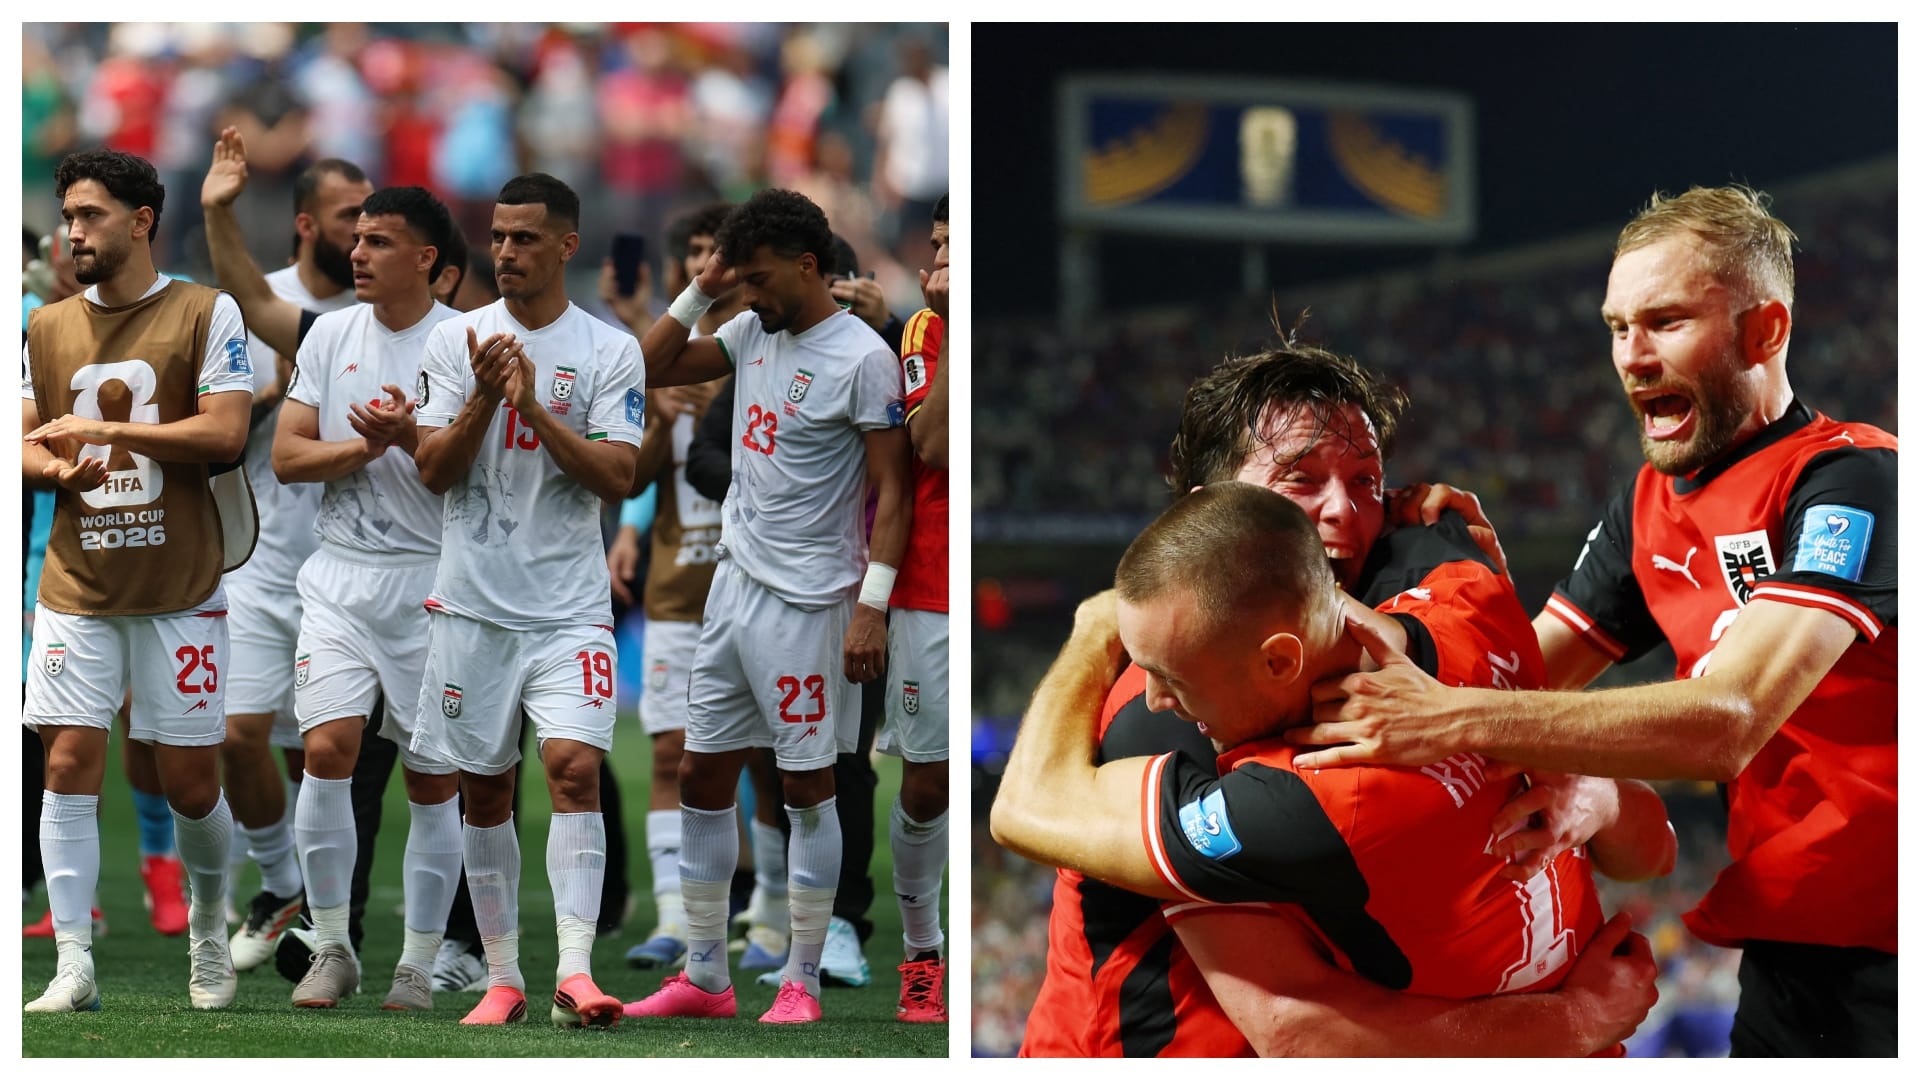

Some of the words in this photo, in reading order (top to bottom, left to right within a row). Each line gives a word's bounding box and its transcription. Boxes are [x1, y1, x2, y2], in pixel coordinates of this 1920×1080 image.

[743, 404, 777, 456] 23
[104, 477, 144, 495] FIFA
[80, 512, 136, 529] WORLD
[138, 509, 165, 524] CUP
[80, 525, 166, 551] 2026
[1838, 538, 1852, 552] For
[1813, 547, 1848, 566] PEACE
[1818, 562, 1837, 572] FIFA
[175, 645, 217, 694] 25
[575, 651, 613, 699] 19
[776, 674, 826, 723] 23
